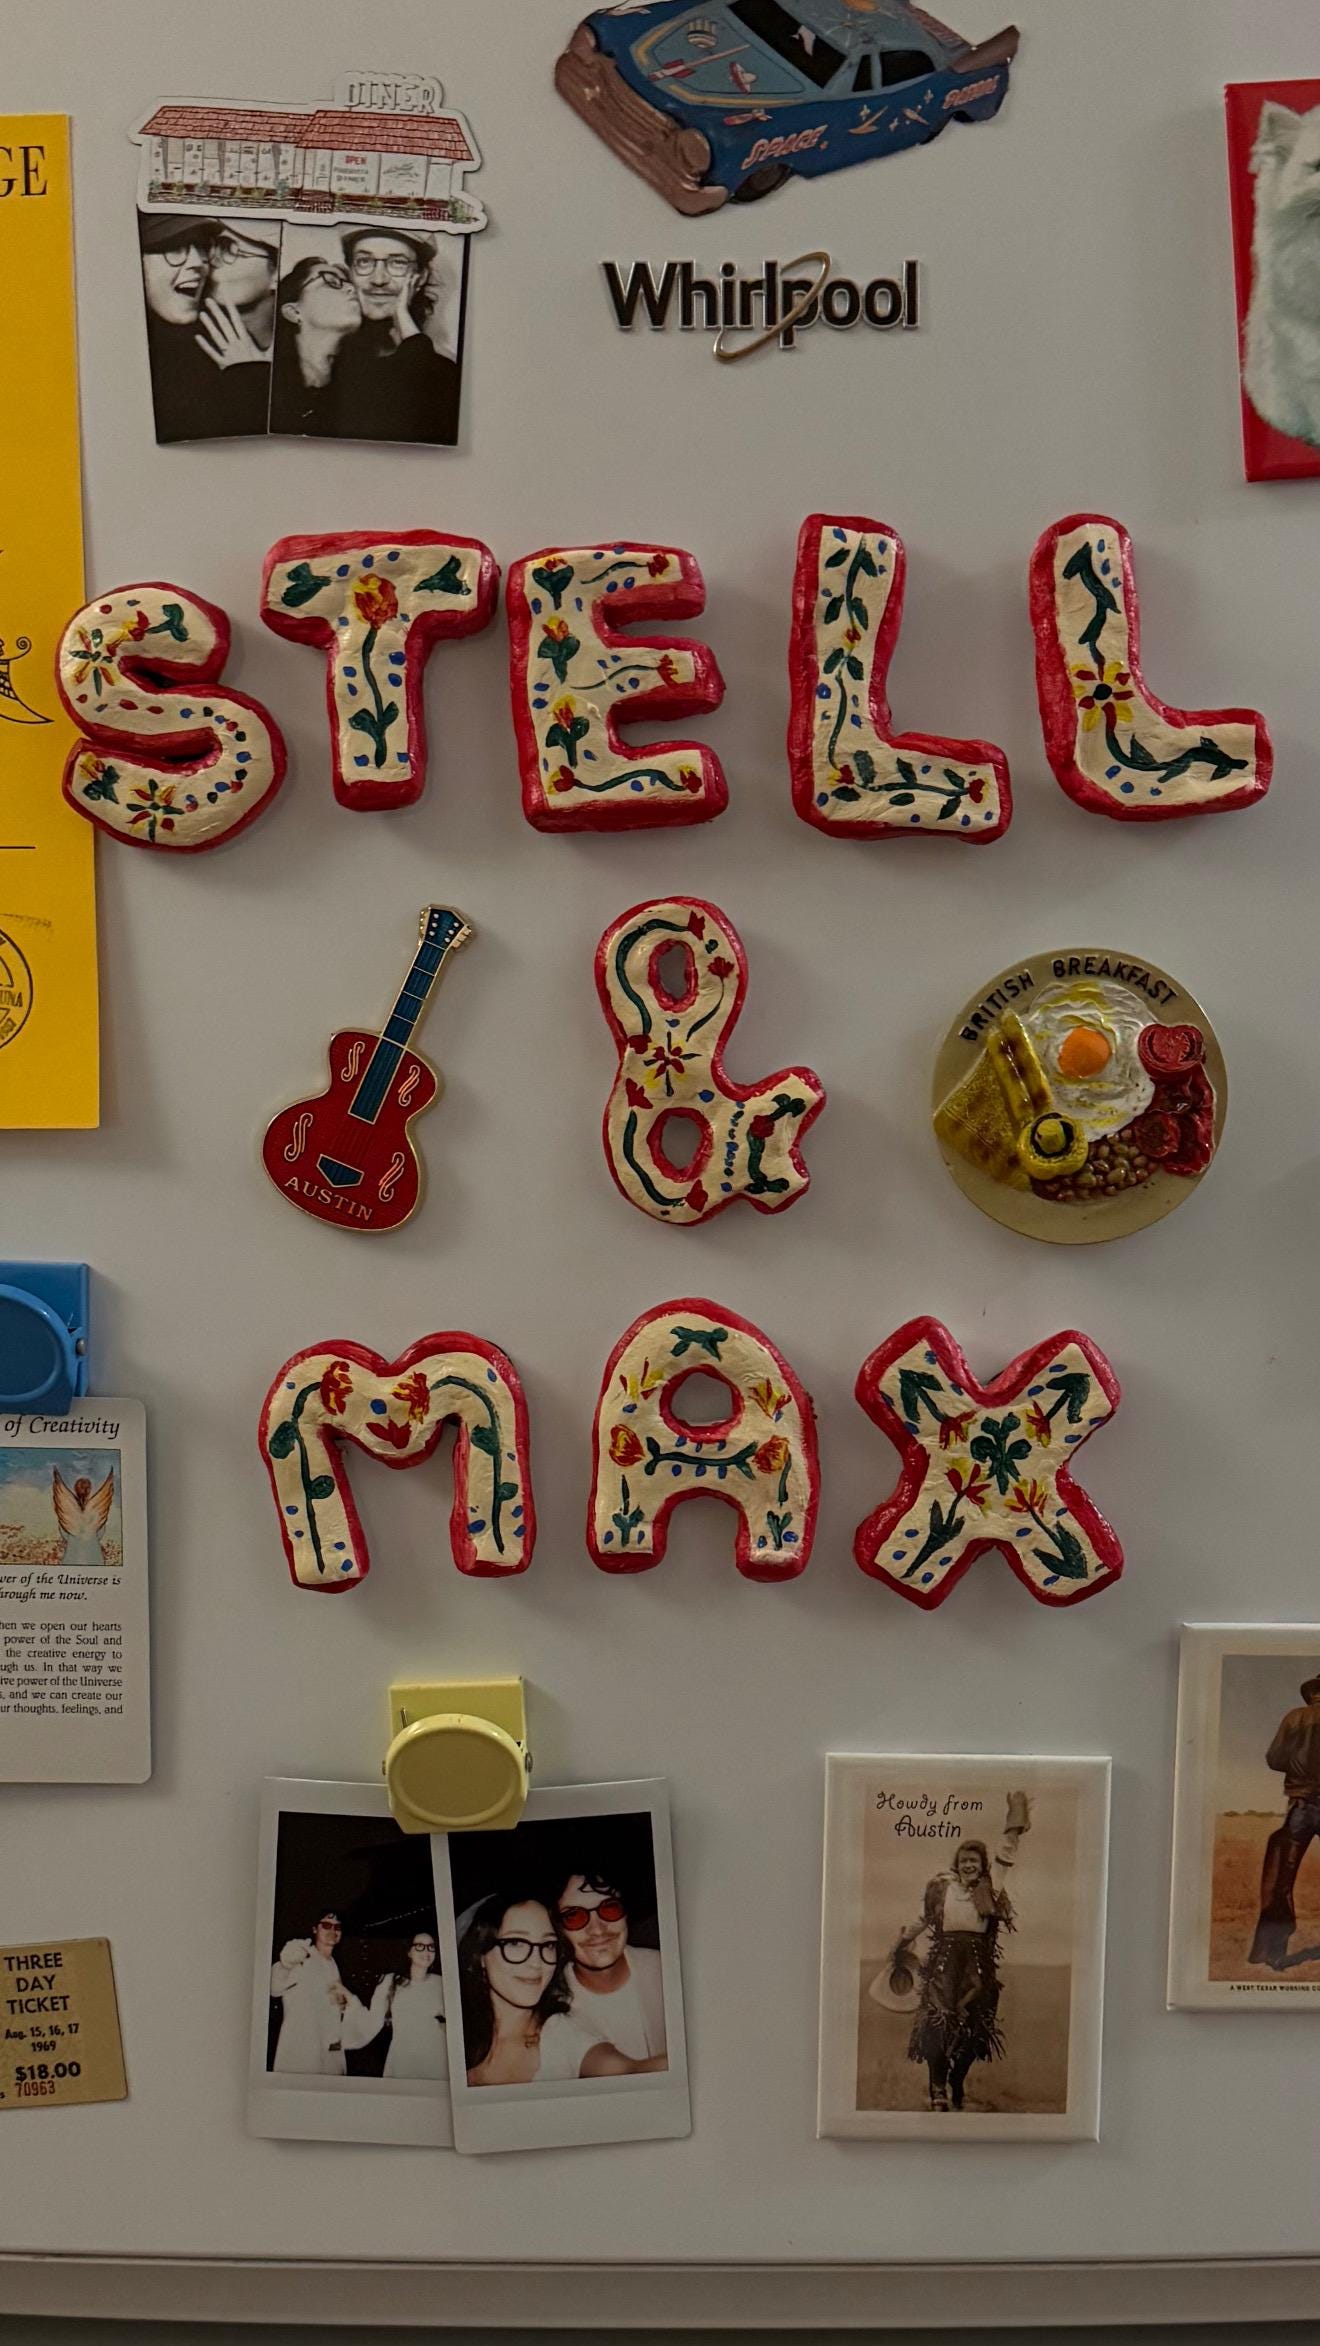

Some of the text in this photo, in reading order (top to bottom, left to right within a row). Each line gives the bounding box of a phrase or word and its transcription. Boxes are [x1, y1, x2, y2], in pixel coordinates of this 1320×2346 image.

[344, 80, 435, 115] DINER
[345, 155, 368, 165] OPEN
[603, 259, 920, 349] Whirlpool
[959, 956, 1179, 1042] BRITISH BREAKFAST
[594, 895, 827, 1226] &
[284, 1176, 374, 1222] AUSTIN
[5, 1413, 121, 1440] of Creativity
[258, 1297, 1124, 1610] MAX
[20, 1571, 35, 1587] of
[37, 1572, 54, 1585] the
[58, 1573, 109, 1586] Universe
[112, 1574, 122, 1585] is
[40, 1590, 56, 1601] me
[59, 1590, 89, 1601] now.
[22, 1623, 36, 1631] we
[40, 1623, 66, 1634] open
[70, 1623, 88, 1632] our
[92, 1621, 123, 1632] hearts
[4, 1633, 123, 1647] power of the Soul and
[6, 1648, 123, 1662] the creative energy to
[24, 1665, 38, 1673] us.
[43, 1661, 54, 1673] In
[58, 1662, 78, 1673] that
[82, 1666, 104, 1675] way
[16, 1677, 48, 1689] power
[50, 1674, 61, 1686] of
[62, 1675, 79, 1687] the
[80, 1675, 124, 1688] Universe
[9, 1689, 28, 1700] and
[31, 1692, 47, 1701] we
[50, 1692, 68, 1701] can
[71, 1691, 103, 1702] create
[105, 1692, 123, 1702] our
[62, 1703, 102, 1717] feelings,
[104, 1704, 124, 1716] and
[876, 1790, 984, 1817] Howdy from
[893, 1814, 962, 1839] Austin
[3, 1952, 64, 1972] THREE
[15, 1974, 57, 1993] DAY
[6, 1995, 71, 2015] TICKET
[4, 2022, 80, 2040] Aug. 15, 16, 17
[31, 2039, 57, 2052] 1969
[15, 2060, 82, 2083] $18.00
[14, 2079, 57, 2099] 70963
